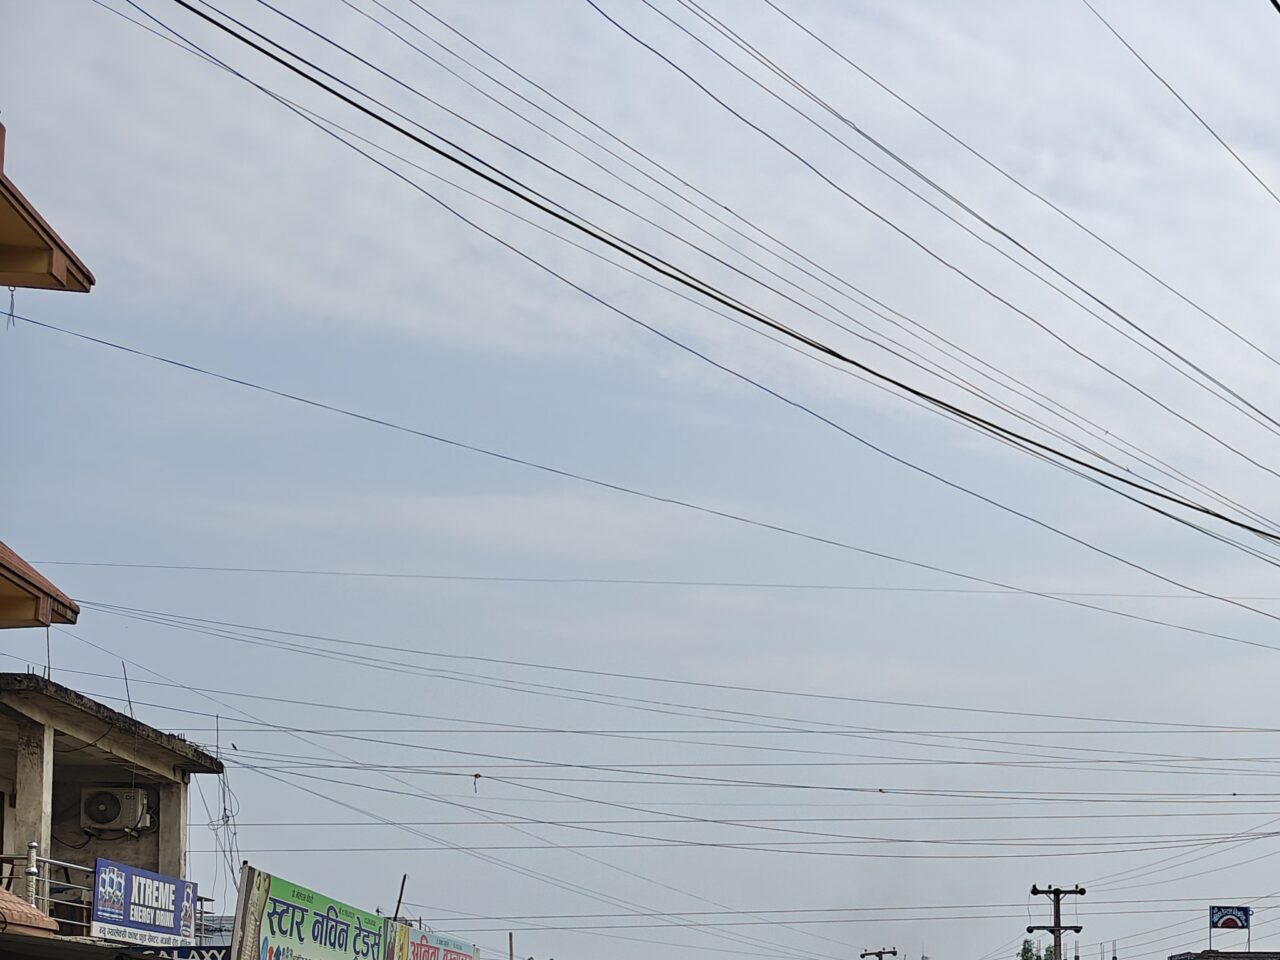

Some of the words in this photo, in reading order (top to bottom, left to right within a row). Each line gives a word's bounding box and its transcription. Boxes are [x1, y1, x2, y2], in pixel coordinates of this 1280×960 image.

[130, 874, 176, 911] XTREME
[130, 905, 155, 925] ENERGY
[155, 910, 174, 929] DRINK
[267, 896, 309, 944] स्टार
[311, 905, 351, 954] नविन
